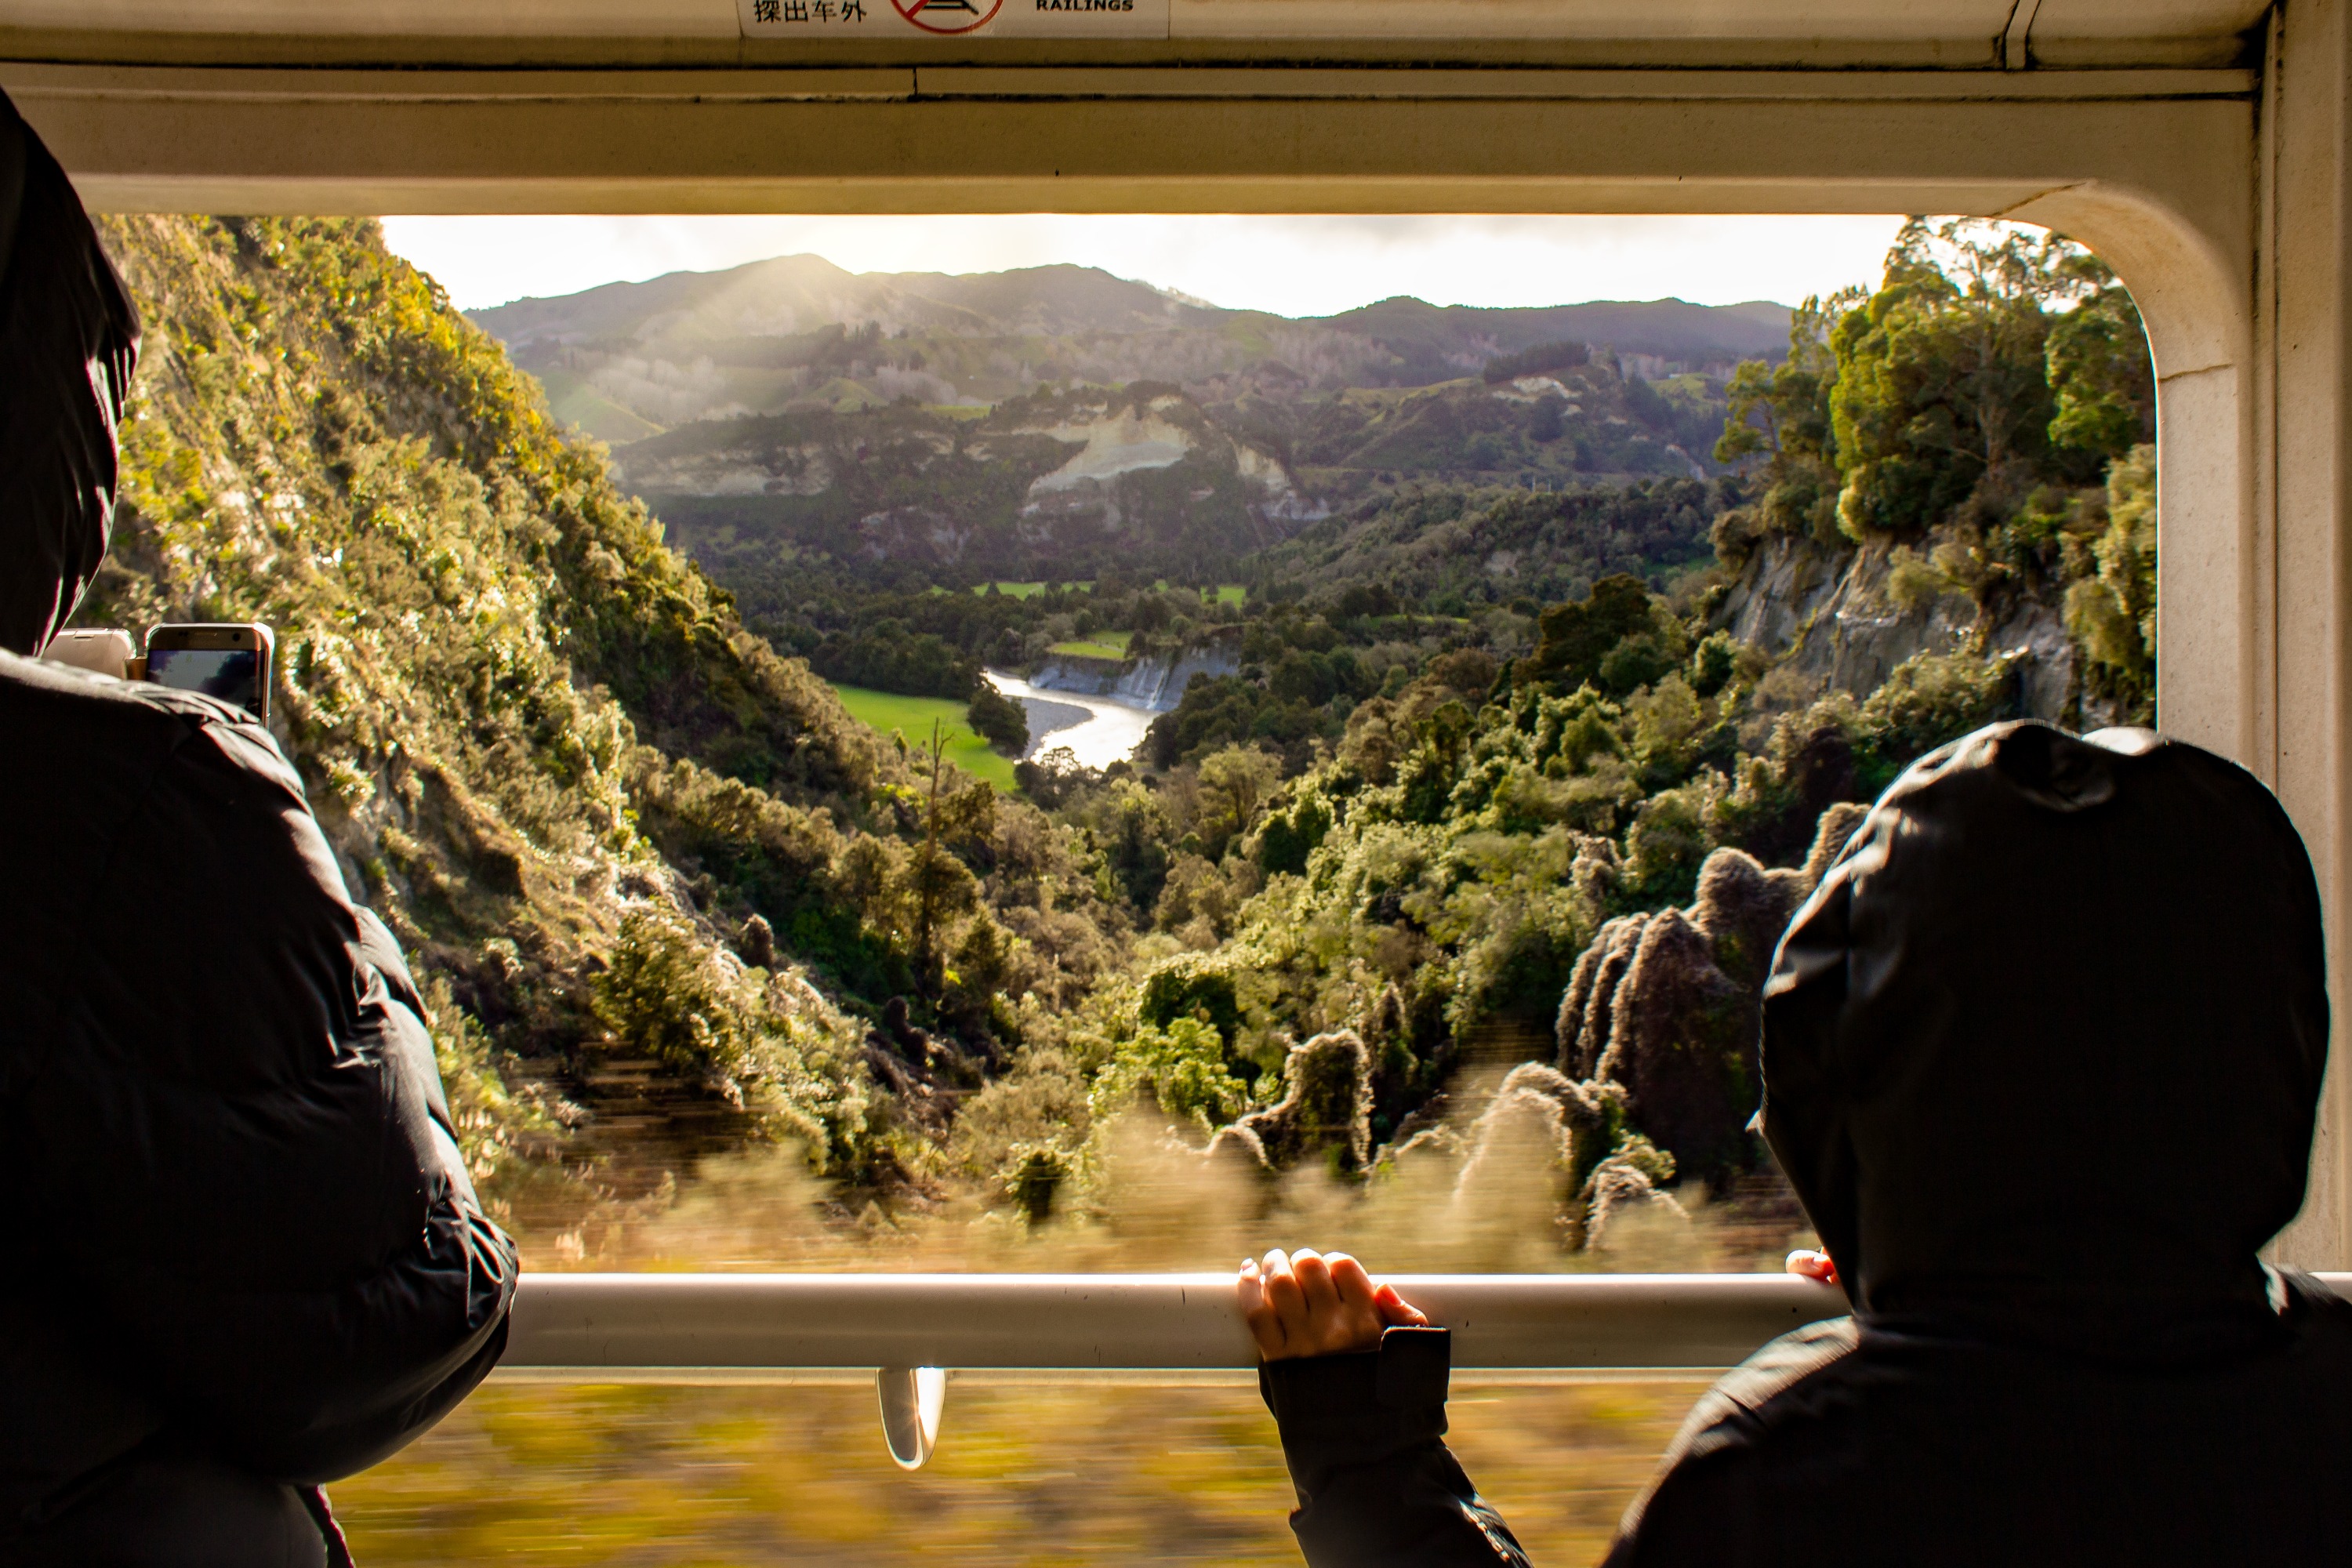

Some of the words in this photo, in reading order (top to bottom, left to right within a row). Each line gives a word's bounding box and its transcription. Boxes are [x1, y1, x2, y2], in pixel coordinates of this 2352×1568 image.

[753, 0, 867, 24] 探出车外
[1036, 0, 1134, 11] RAILINGS
